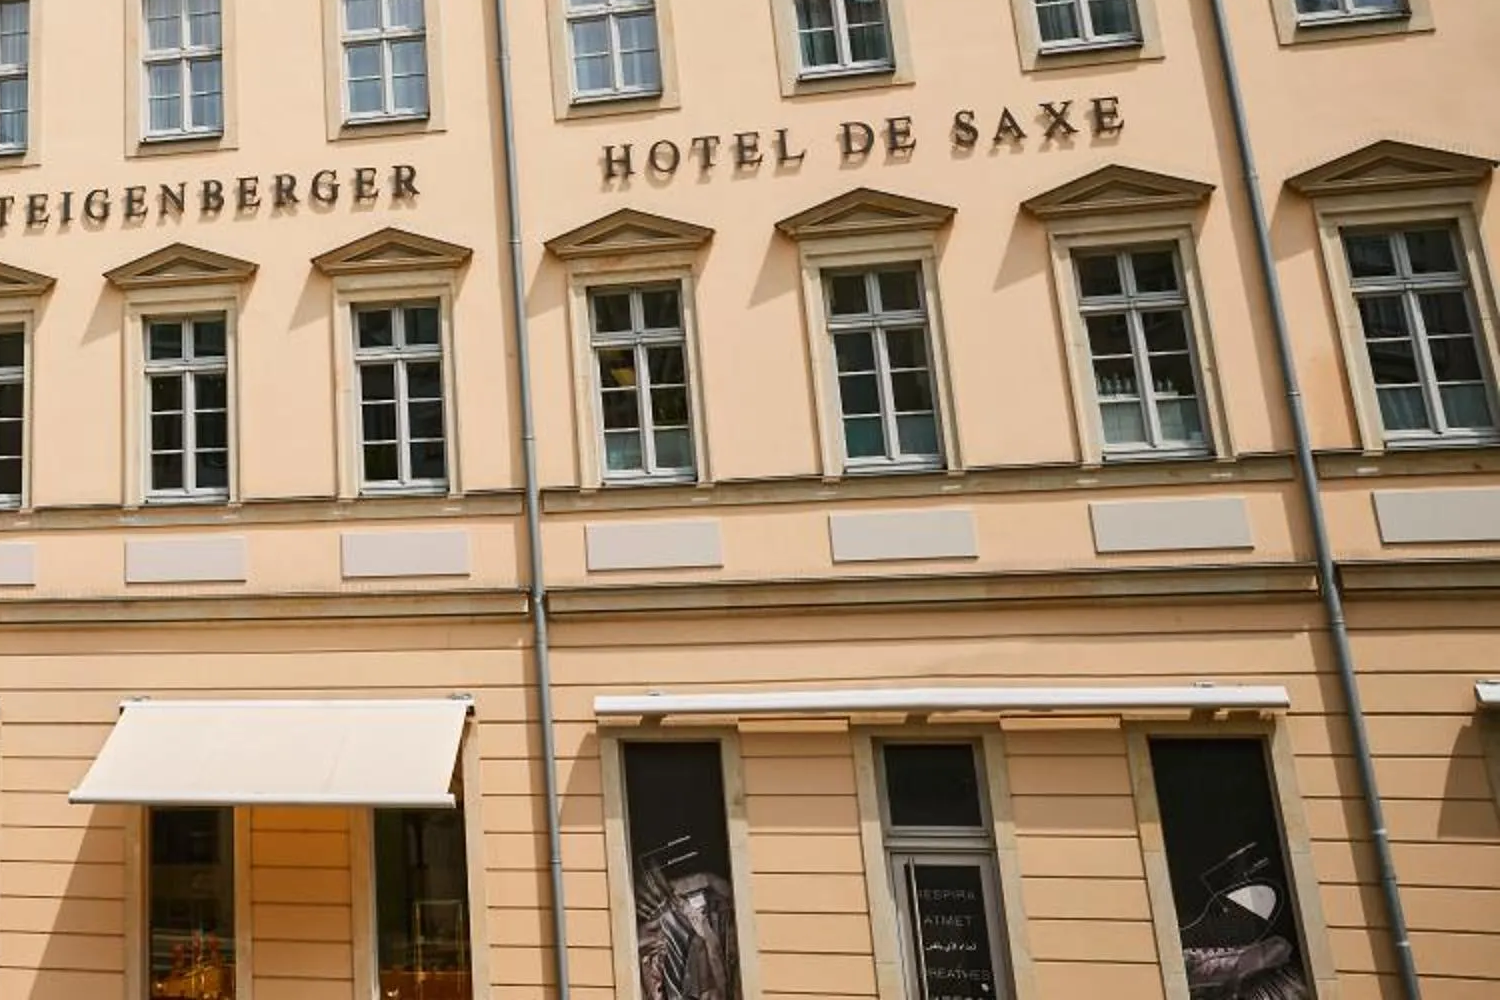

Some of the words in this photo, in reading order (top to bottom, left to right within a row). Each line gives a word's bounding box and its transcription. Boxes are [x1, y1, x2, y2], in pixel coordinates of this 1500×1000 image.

[603, 128, 806, 179] HOTEL
[841, 116, 917, 157] DE
[953, 96, 1126, 147] SAXE
